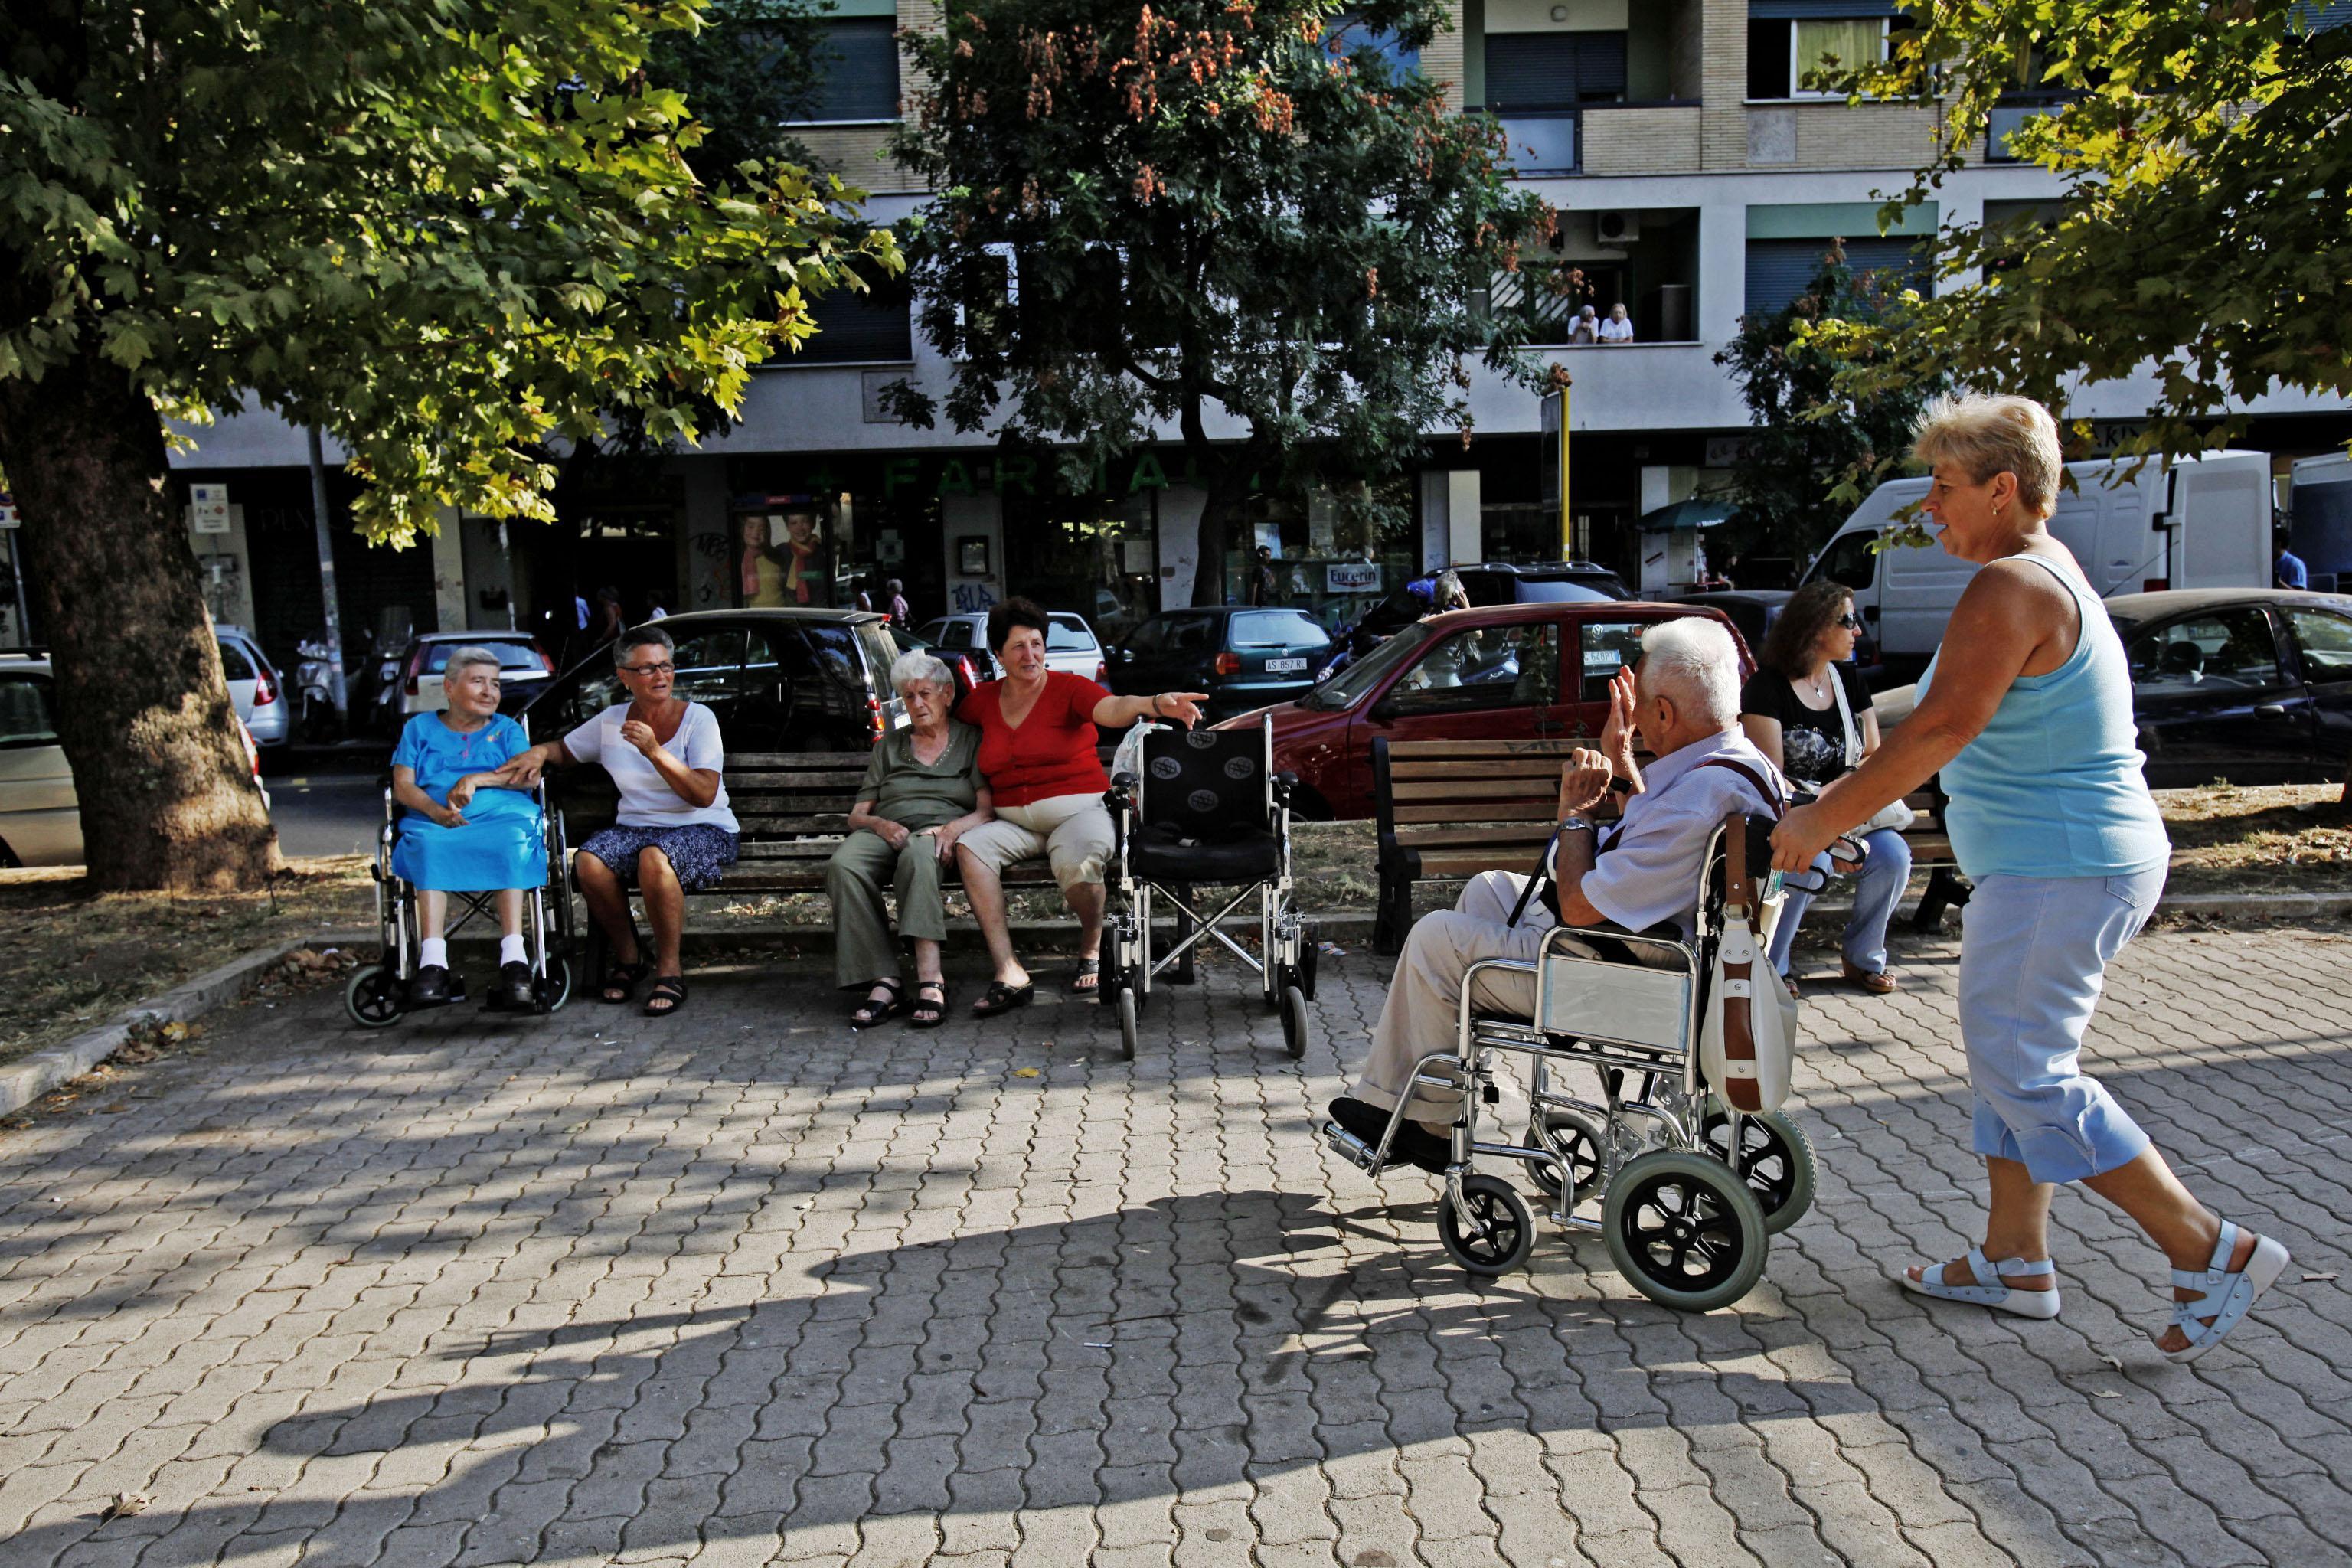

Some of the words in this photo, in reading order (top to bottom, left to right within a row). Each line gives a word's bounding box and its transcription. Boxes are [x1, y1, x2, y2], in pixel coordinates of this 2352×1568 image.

[1330, 568, 1376, 583] Eucerin
[1267, 661, 1276, 670] AS
[1280, 660, 1294, 668] 857
[1296, 659, 1305, 668] RL
